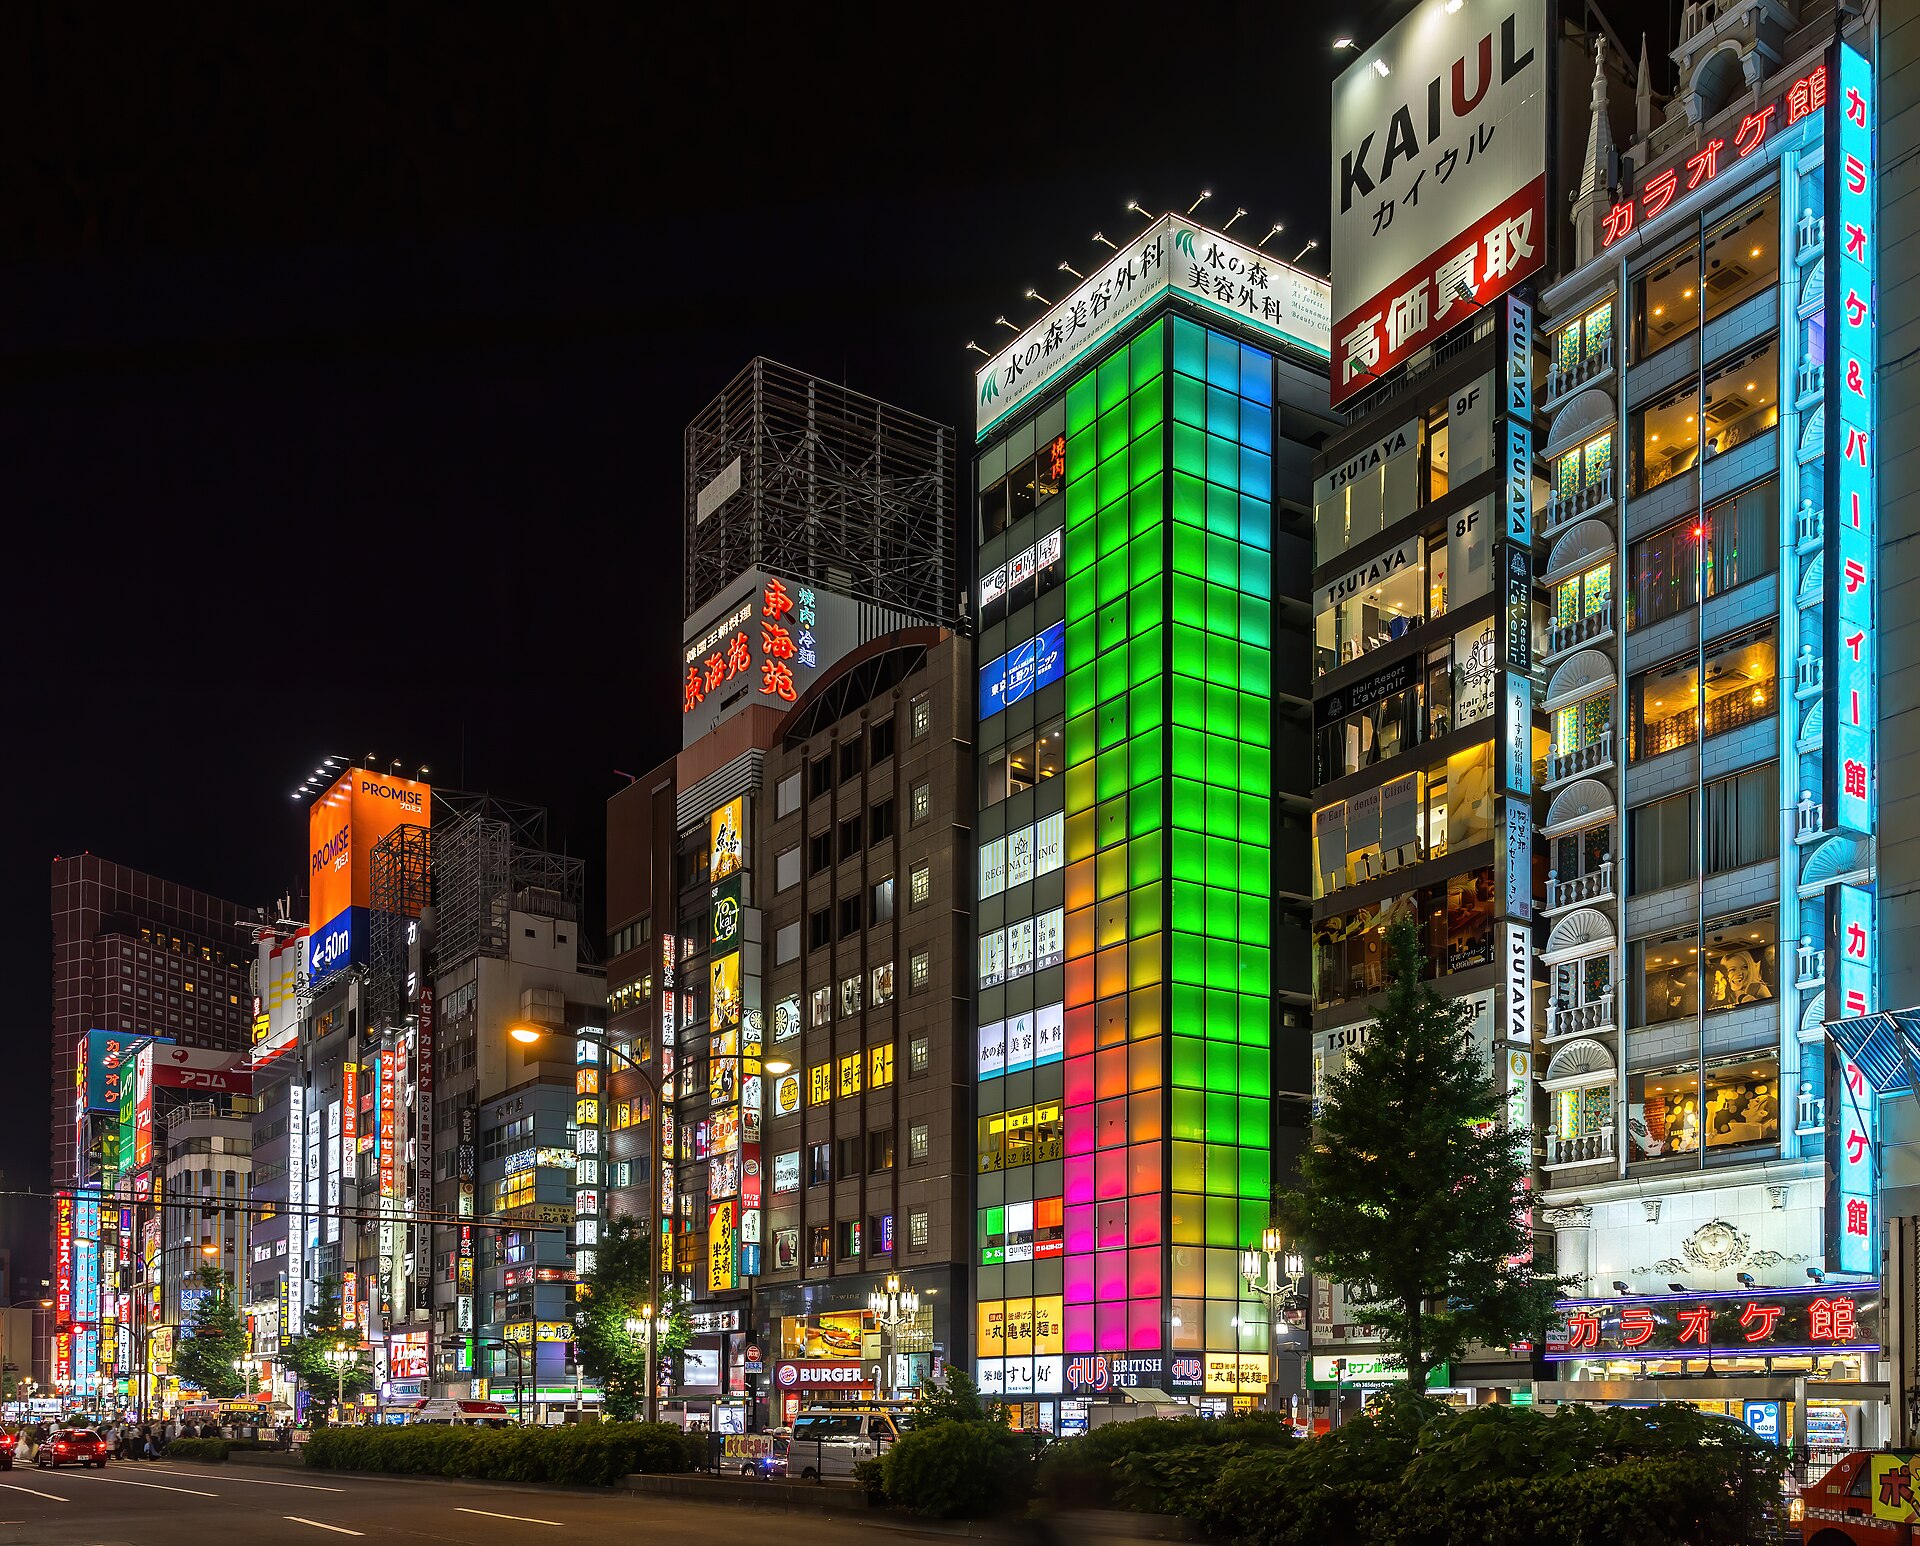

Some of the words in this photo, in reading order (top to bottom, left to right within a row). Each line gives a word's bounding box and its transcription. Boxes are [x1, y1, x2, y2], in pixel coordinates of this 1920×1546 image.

[1340, 19, 1535, 215] KAIUL
[1602, 65, 1829, 247] カラオケ館
[1372, 124, 1495, 237] カイウル
[1203, 242, 1269, 290] 水の森
[1003, 234, 1165, 389] 水の森美容外科
[1112, 296, 1138, 320] Beauty
[1139, 276, 1162, 299] Clinic
[1188, 262, 1283, 325] 美容外科
[1340, 207, 1535, 385] 高価買取
[1514, 304, 1527, 410] TSUTAYA
[1455, 389, 1481, 416] 9F
[1051, 436, 1065, 480] 焼肉
[1329, 431, 1407, 491] TSUTAYA
[1512, 432, 1527, 535] TSUTAYA
[1455, 510, 1480, 538] 8F
[1328, 549, 1407, 603] TSUTAYA
[1520, 583, 1528, 614] Hair
[759, 577, 798, 703] 東海苑
[1510, 579, 1518, 662] L'avenir
[1520, 618, 1528, 665] Resort
[684, 631, 751, 713] 東海苑
[1352, 681, 1372, 697] Hair
[1374, 665, 1405, 685] Resort
[1352, 675, 1405, 707] L'avenir
[1459, 696, 1480, 711] Hair
[1513, 694, 1524, 790] あーす新宿歯科
[361, 780, 423, 806] PROMISE
[400, 801, 422, 814] プロミス
[1328, 805, 1352, 822] Earth
[1353, 793, 1381, 812] dental
[1384, 779, 1412, 800] Clinic
[312, 824, 350, 877] PROMISE
[985, 858, 1022, 882] REGINA
[1022, 842, 1058, 867] CLINIC
[324, 928, 350, 963] 50m
[1512, 931, 1526, 1037] TSUTAYA
[420, 990, 433, 1027] パセラ
[180, 1070, 227, 1089] アコム
[382, 1054, 394, 1109] カラオケ
[420, 1034, 432, 1087] カラオケ
[381, 1123, 394, 1166] パセラ
[991, 1320, 1050, 1340] 丸亀製麺
[1569, 1296, 1856, 1349] カラオケ館
[1066, 1356, 1108, 1392] HUB
[1112, 1358, 1162, 1373] BRITISH
[1112, 1373, 1137, 1387] PUB
[1171, 1359, 1202, 1381] HUB
